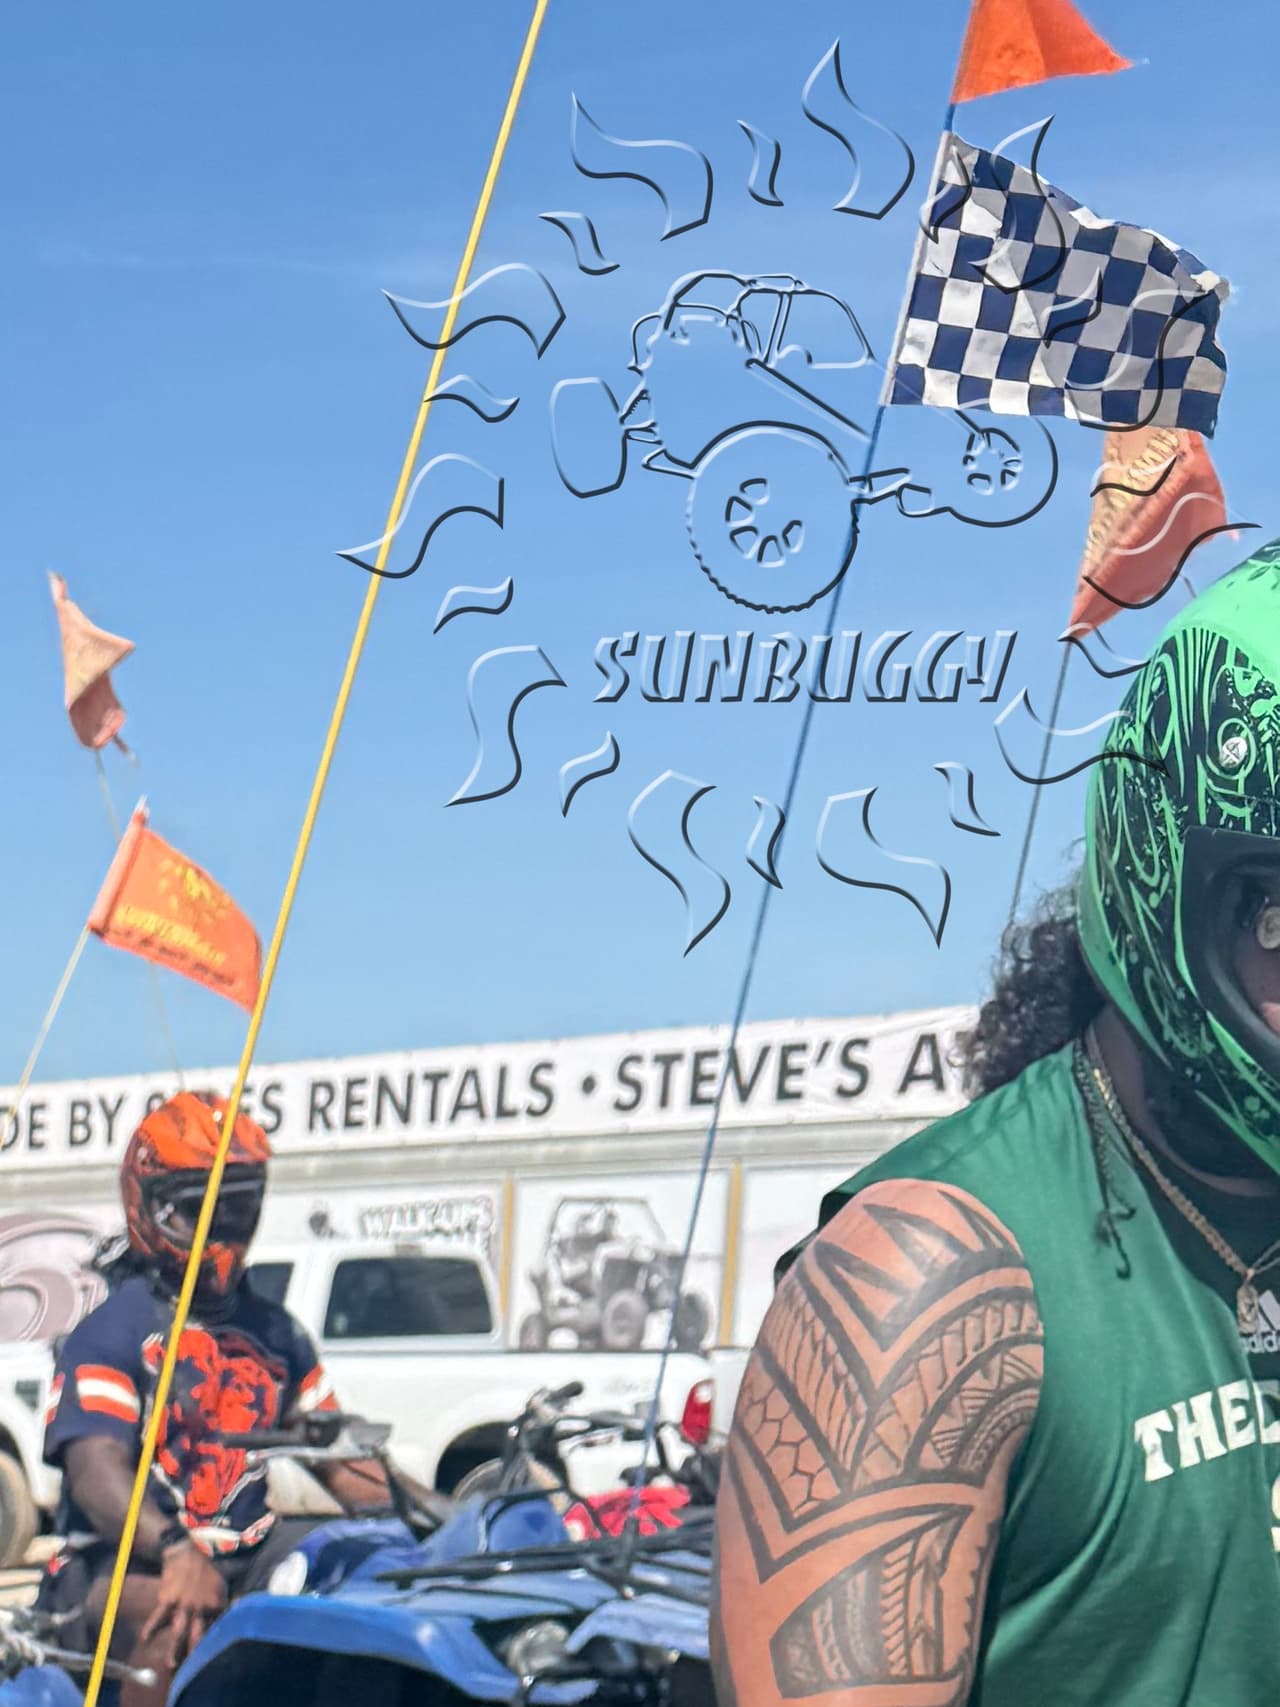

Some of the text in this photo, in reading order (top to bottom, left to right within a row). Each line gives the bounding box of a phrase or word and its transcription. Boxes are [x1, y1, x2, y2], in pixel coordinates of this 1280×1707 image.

[69, 1093, 129, 1147] BY
[308, 1060, 557, 1133] RENTALS
[613, 1037, 870, 1112] STEVE'S
